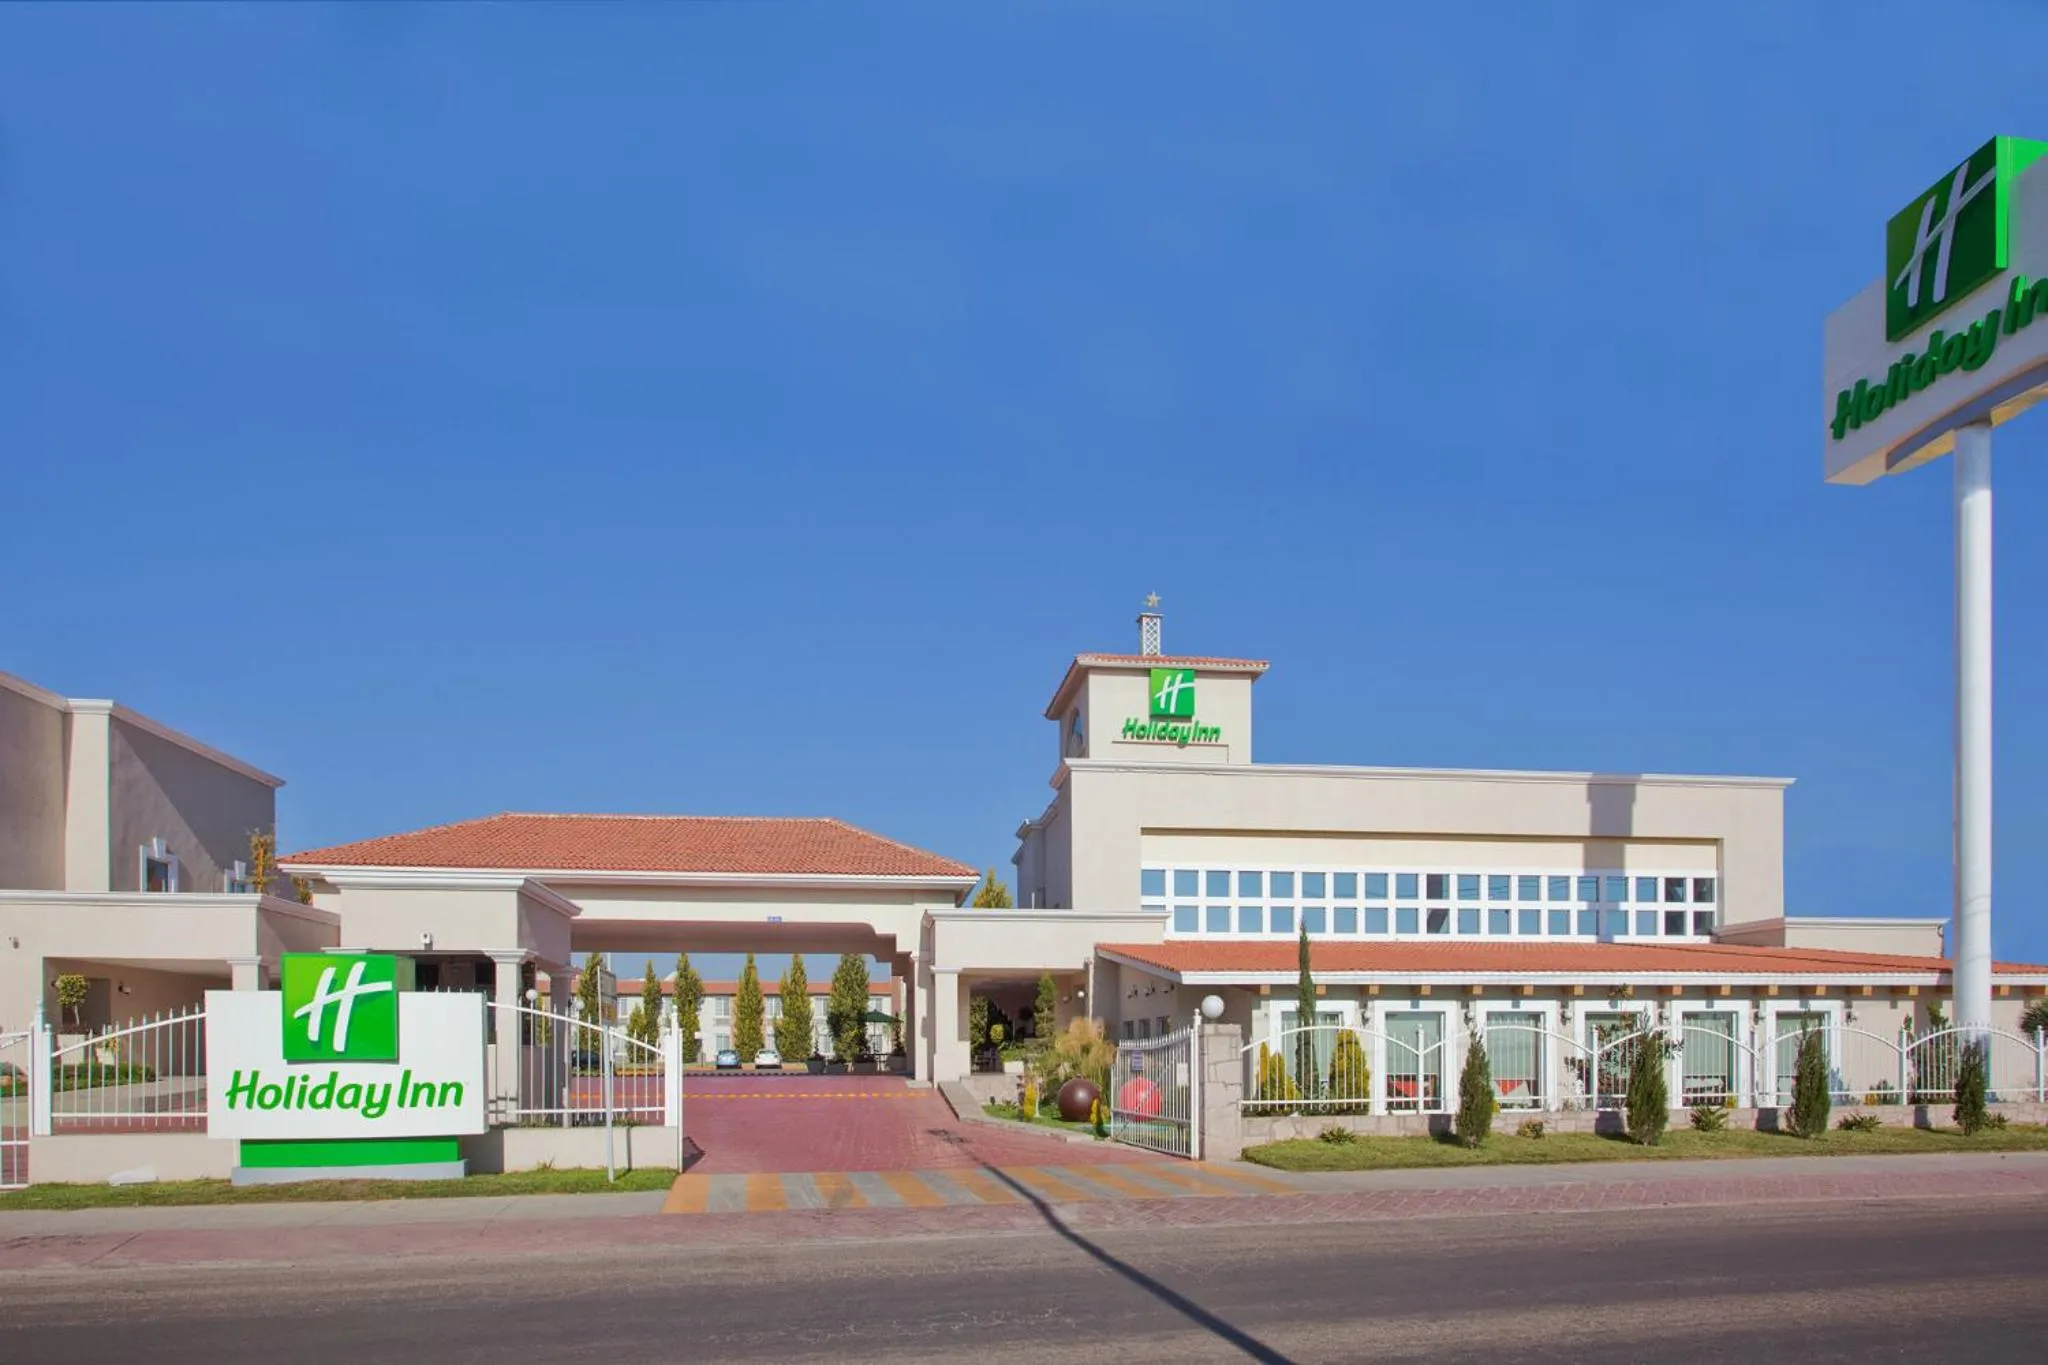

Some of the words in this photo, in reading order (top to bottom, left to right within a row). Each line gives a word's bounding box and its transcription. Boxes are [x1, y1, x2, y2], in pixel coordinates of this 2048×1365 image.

[1893, 160, 1996, 308] H
[1830, 309, 2001, 440] Holiday
[1154, 673, 1194, 713] H
[1122, 717, 1192, 745] Holiday
[1192, 720, 1221, 743] Inn
[293, 961, 393, 1052] H
[225, 1070, 392, 1118] Holiday
[397, 1069, 464, 1108] Inn
